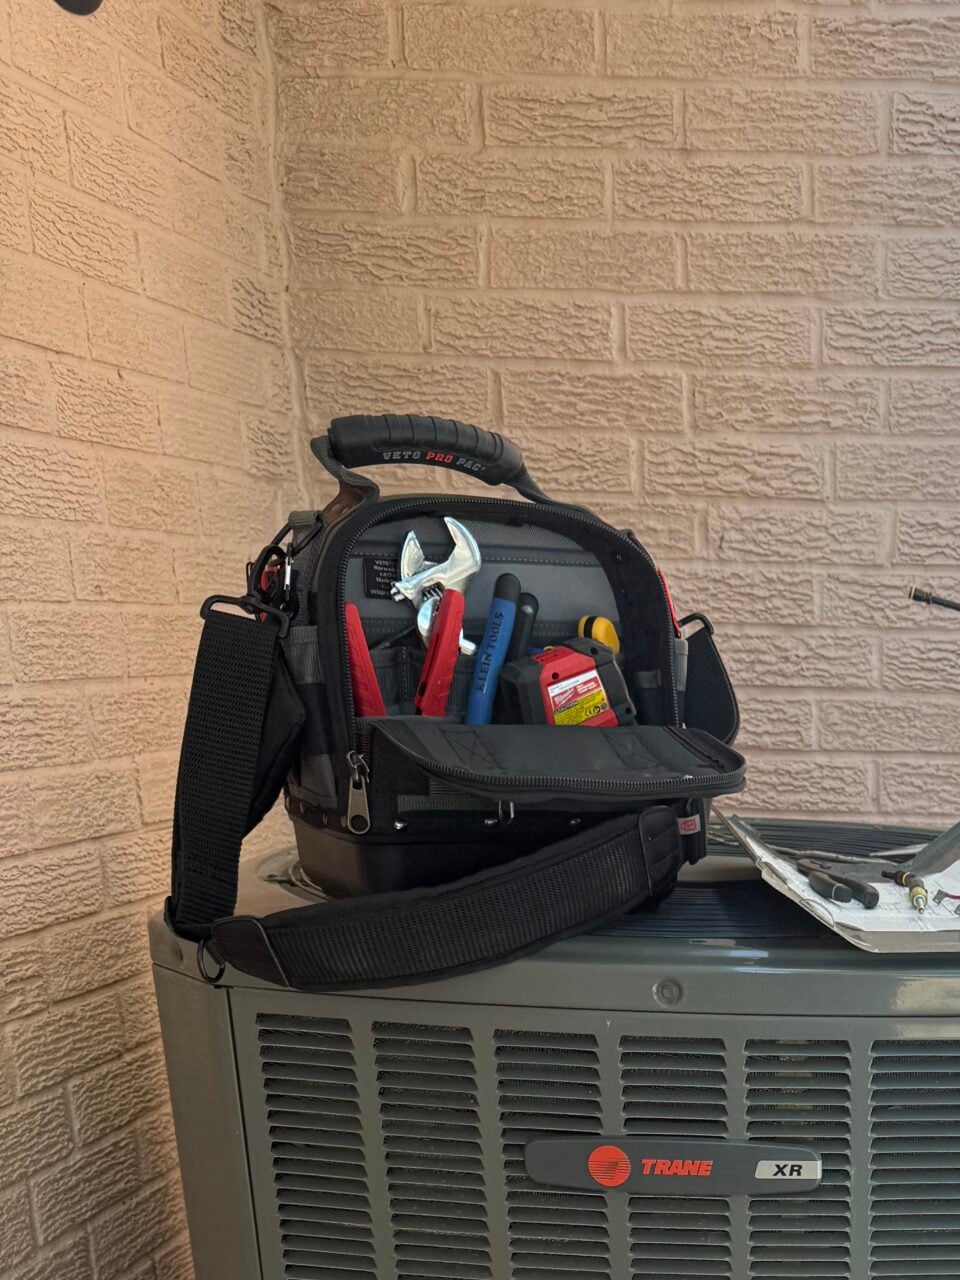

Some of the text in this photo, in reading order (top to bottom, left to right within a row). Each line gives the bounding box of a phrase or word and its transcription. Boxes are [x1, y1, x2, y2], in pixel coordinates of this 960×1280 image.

[382, 451, 421, 460] VETO
[425, 451, 454, 464] PRO
[476, 611, 505, 692] KLEIN TOOLS
[641, 1159, 713, 1176] TRANE
[773, 1164, 803, 1177] XR
